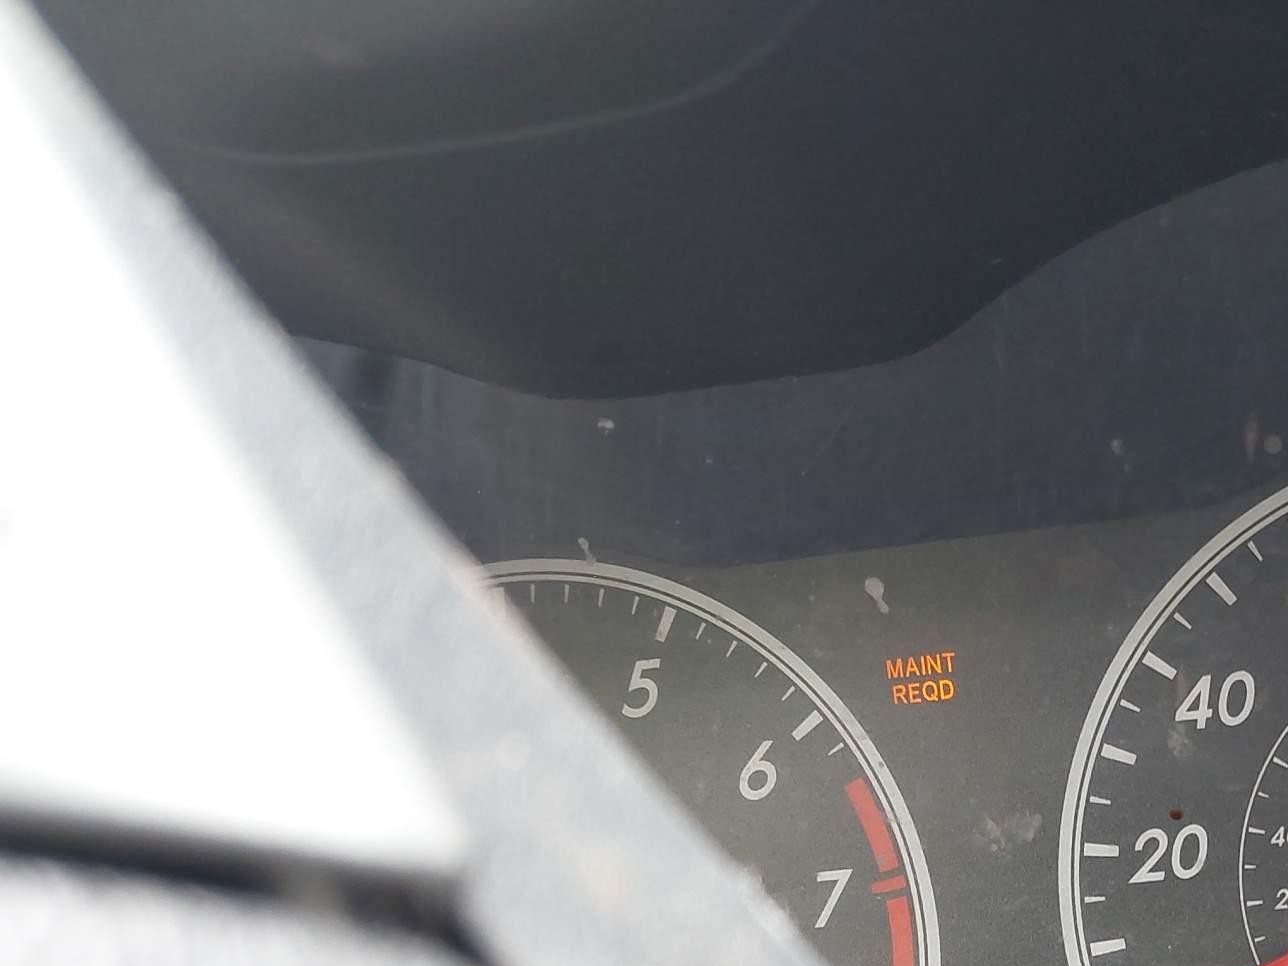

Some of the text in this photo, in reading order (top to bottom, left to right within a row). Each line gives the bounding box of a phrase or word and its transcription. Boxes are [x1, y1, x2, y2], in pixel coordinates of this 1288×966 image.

[622, 658, 661, 718] 5
[885, 652, 956, 680] MAINT
[892, 679, 956, 705] REQD
[1175, 670, 1255, 729] 40
[739, 739, 777, 801] 6
[1128, 823, 1208, 884] 20
[815, 869, 853, 928] 7
